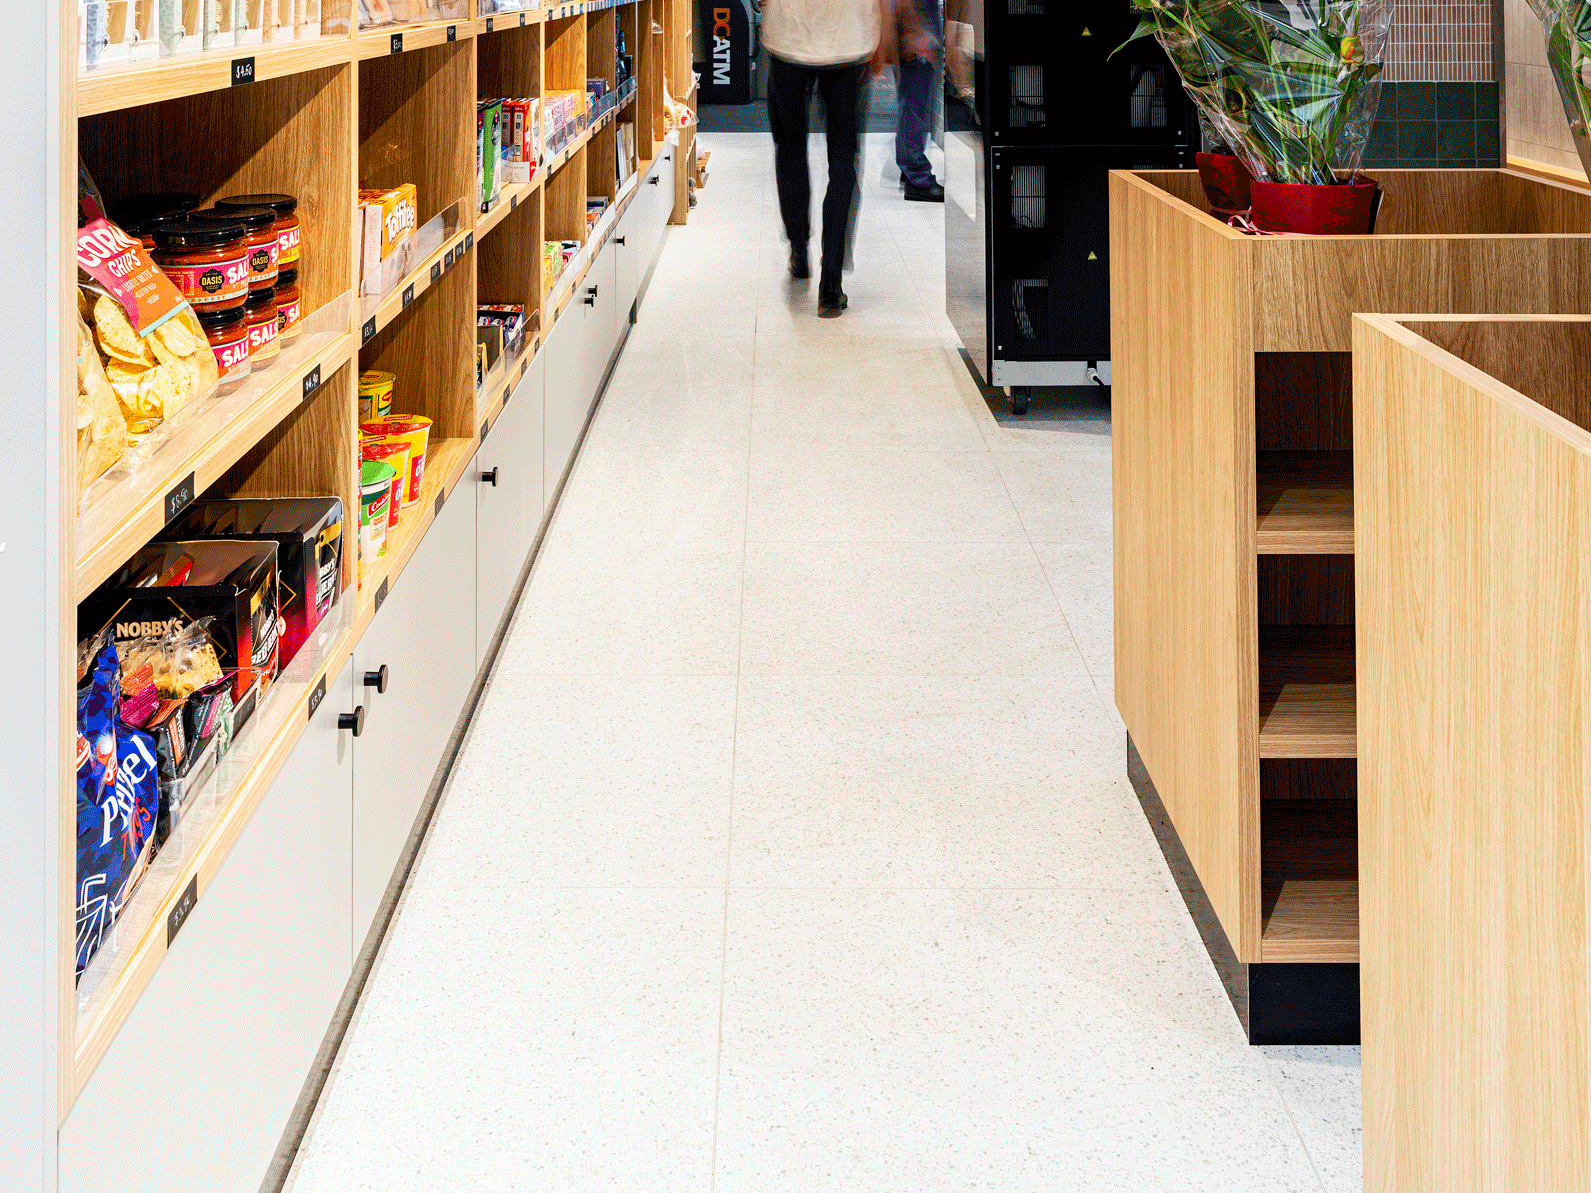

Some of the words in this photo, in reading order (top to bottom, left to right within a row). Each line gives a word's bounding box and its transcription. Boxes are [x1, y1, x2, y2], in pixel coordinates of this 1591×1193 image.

[77, 225, 140, 268] CORN
[107, 248, 142, 278] CHIPS
[252, 255, 269, 267] OASIS
[201, 275, 223, 287] OASIS
[116, 619, 184, 639] NOBBY'S
